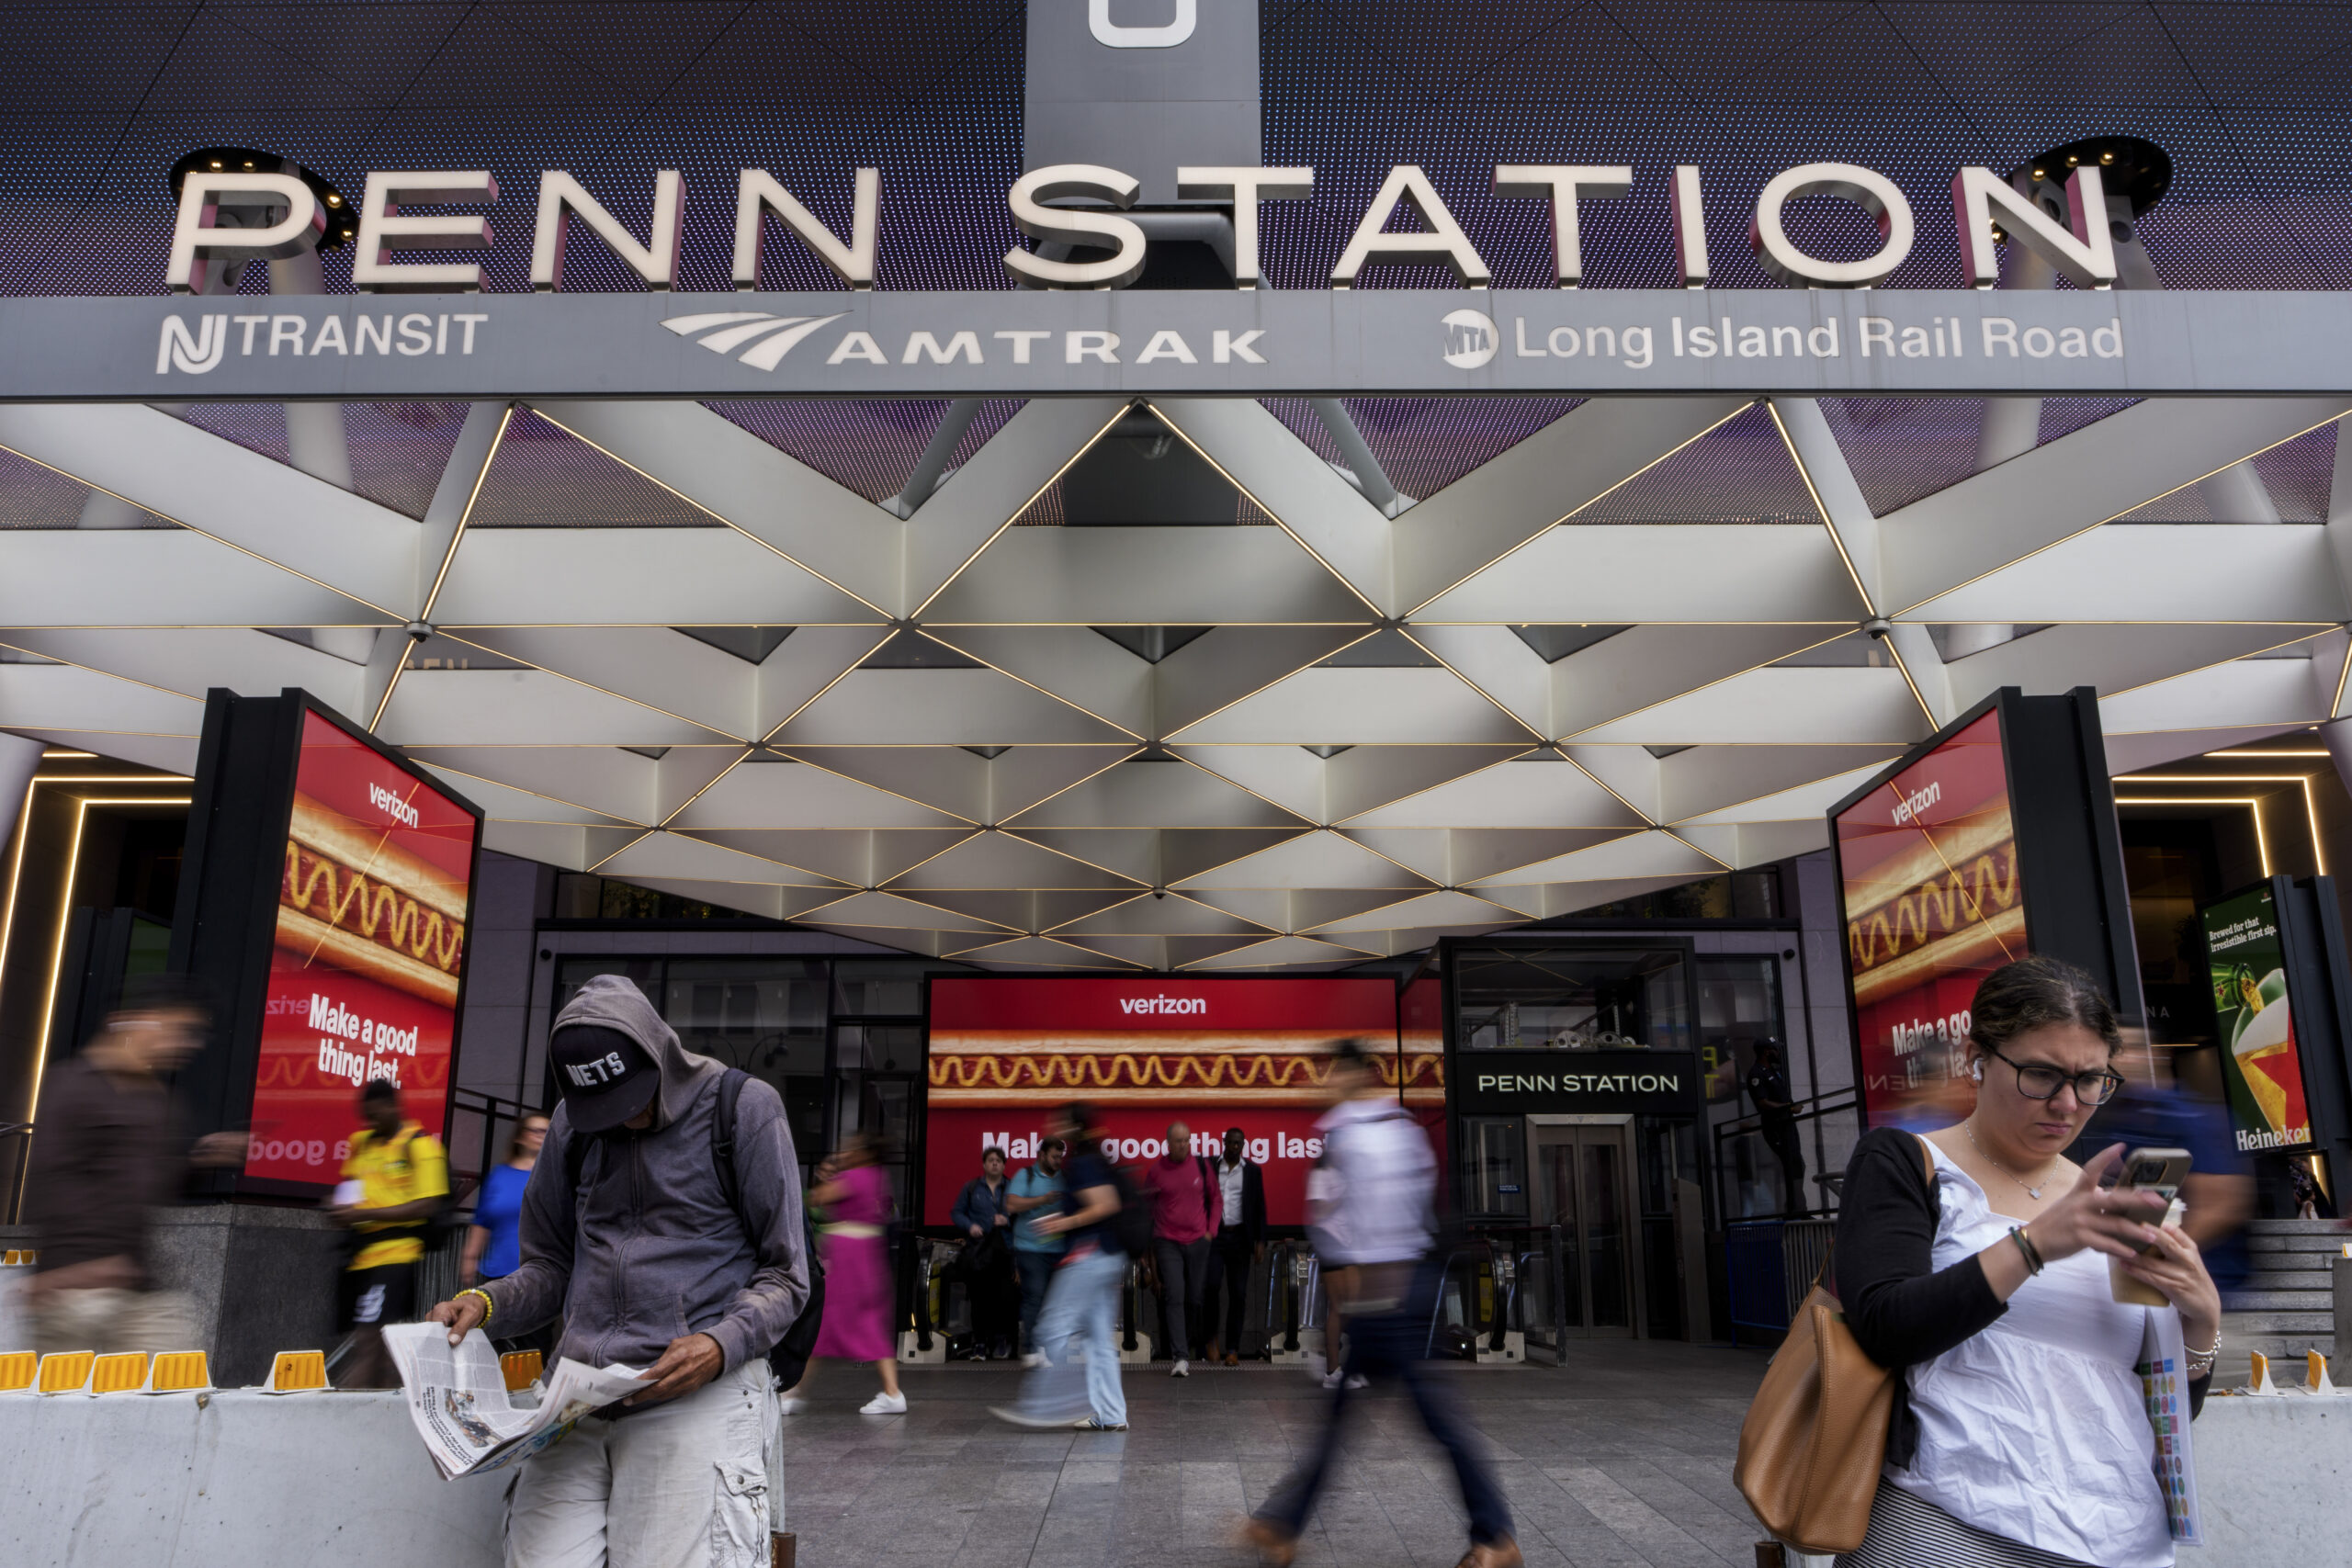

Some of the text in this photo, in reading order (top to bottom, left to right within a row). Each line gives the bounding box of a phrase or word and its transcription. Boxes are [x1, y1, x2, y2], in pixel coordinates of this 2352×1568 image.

[166, 163, 2119, 291] PENN STATION
[232, 313, 489, 356] TRANSIT
[825, 329, 1270, 365] AMTRAK
[1516, 316, 2124, 368] Long Island Rail Road
[368, 782, 419, 829] verizon
[1892, 780, 1941, 826] verizon
[2209, 916, 2260, 941] Brewed for that
[2211, 924, 2277, 953] irresistible first sip.
[309, 993, 418, 1056] Make a good
[1120, 995, 1206, 1014] verizon
[1892, 1010, 1972, 1056] Make a go
[318, 1038, 401, 1089] thing last.
[565, 1052, 626, 1087] NETS
[1477, 1074, 1679, 1093] PENN STATION
[982, 1132, 1067, 1159] Mak
